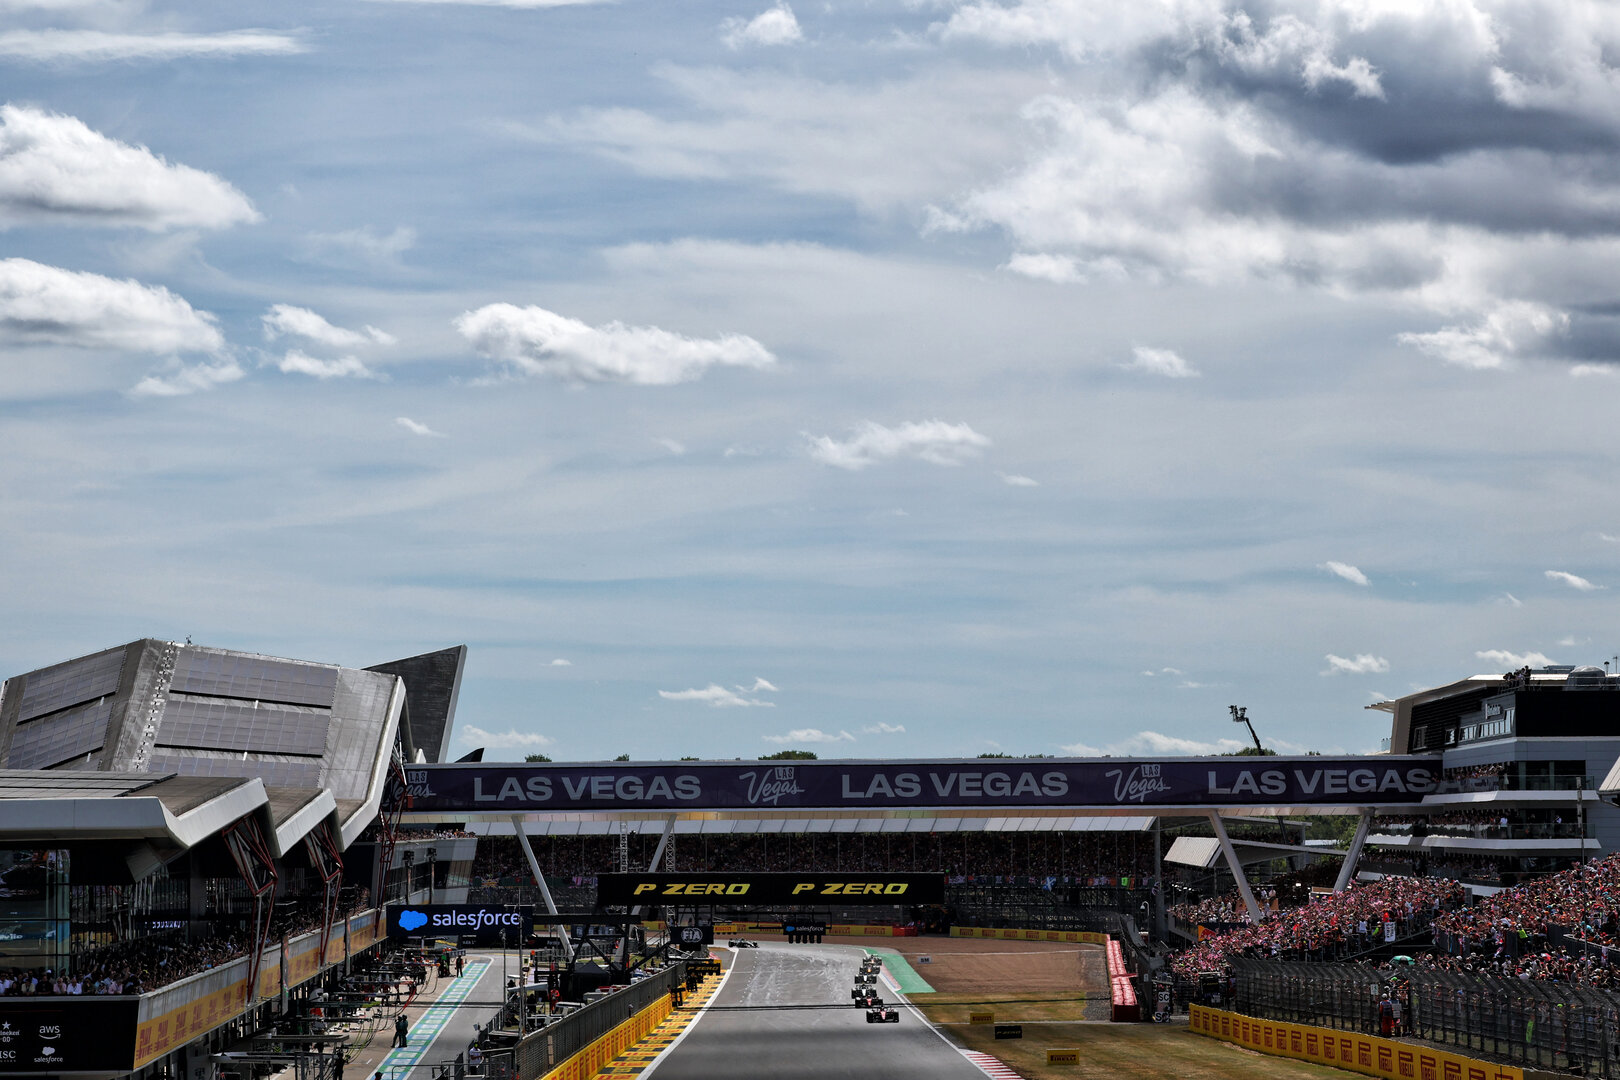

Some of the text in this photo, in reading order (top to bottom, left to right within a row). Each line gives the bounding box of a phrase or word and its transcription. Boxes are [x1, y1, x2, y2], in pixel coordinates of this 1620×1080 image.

[776, 767, 793, 779] LAS
[1142, 765, 1159, 776] LAS
[409, 772, 426, 782] LAS
[1208, 768, 1434, 795] LAS VEGAS
[475, 775, 701, 801] LAS VEGAS
[739, 769, 805, 805] Vegas
[842, 771, 1069, 798] LAS VEGAS
[1105, 766, 1171, 802] Vegas
[633, 884, 750, 894] P ZERO
[792, 884, 909, 894] P ZERO
[432, 909, 520, 931] salesforce
[682, 930, 701, 940] FIA
[1158, 993, 1170, 1001] SC
[39, 1025, 60, 1033] aws
[0, 1050, 16, 1058] SC
[34, 1056, 63, 1064] salesforce
